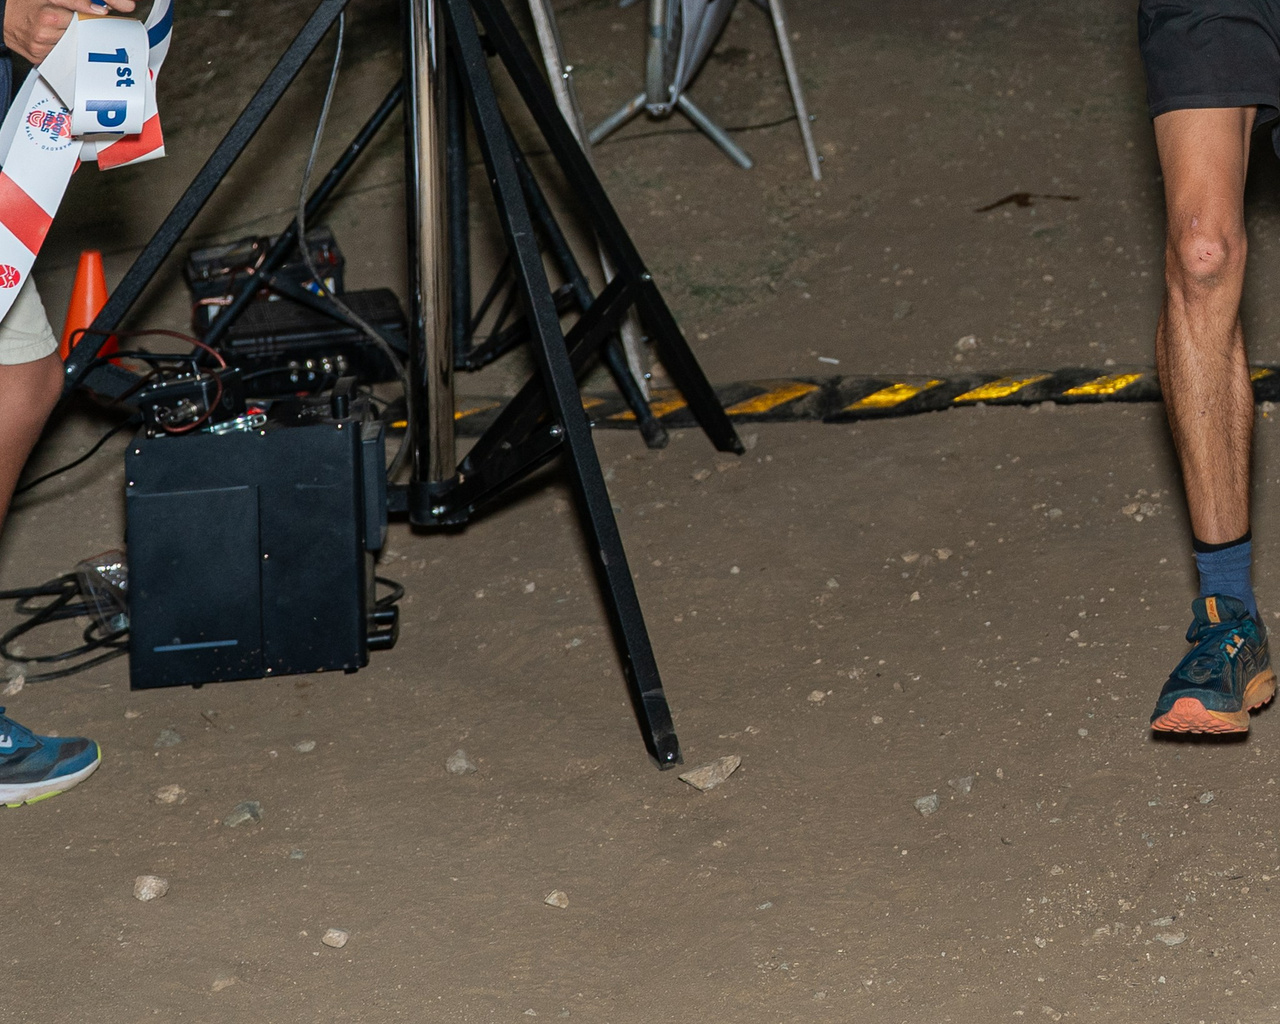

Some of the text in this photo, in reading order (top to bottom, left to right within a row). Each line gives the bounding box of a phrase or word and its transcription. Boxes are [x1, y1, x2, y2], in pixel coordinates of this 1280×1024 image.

[87, 47, 135, 88] 1st
[40, 110, 55, 133] HILLS
[49, 107, 69, 142] PLOVDIV
